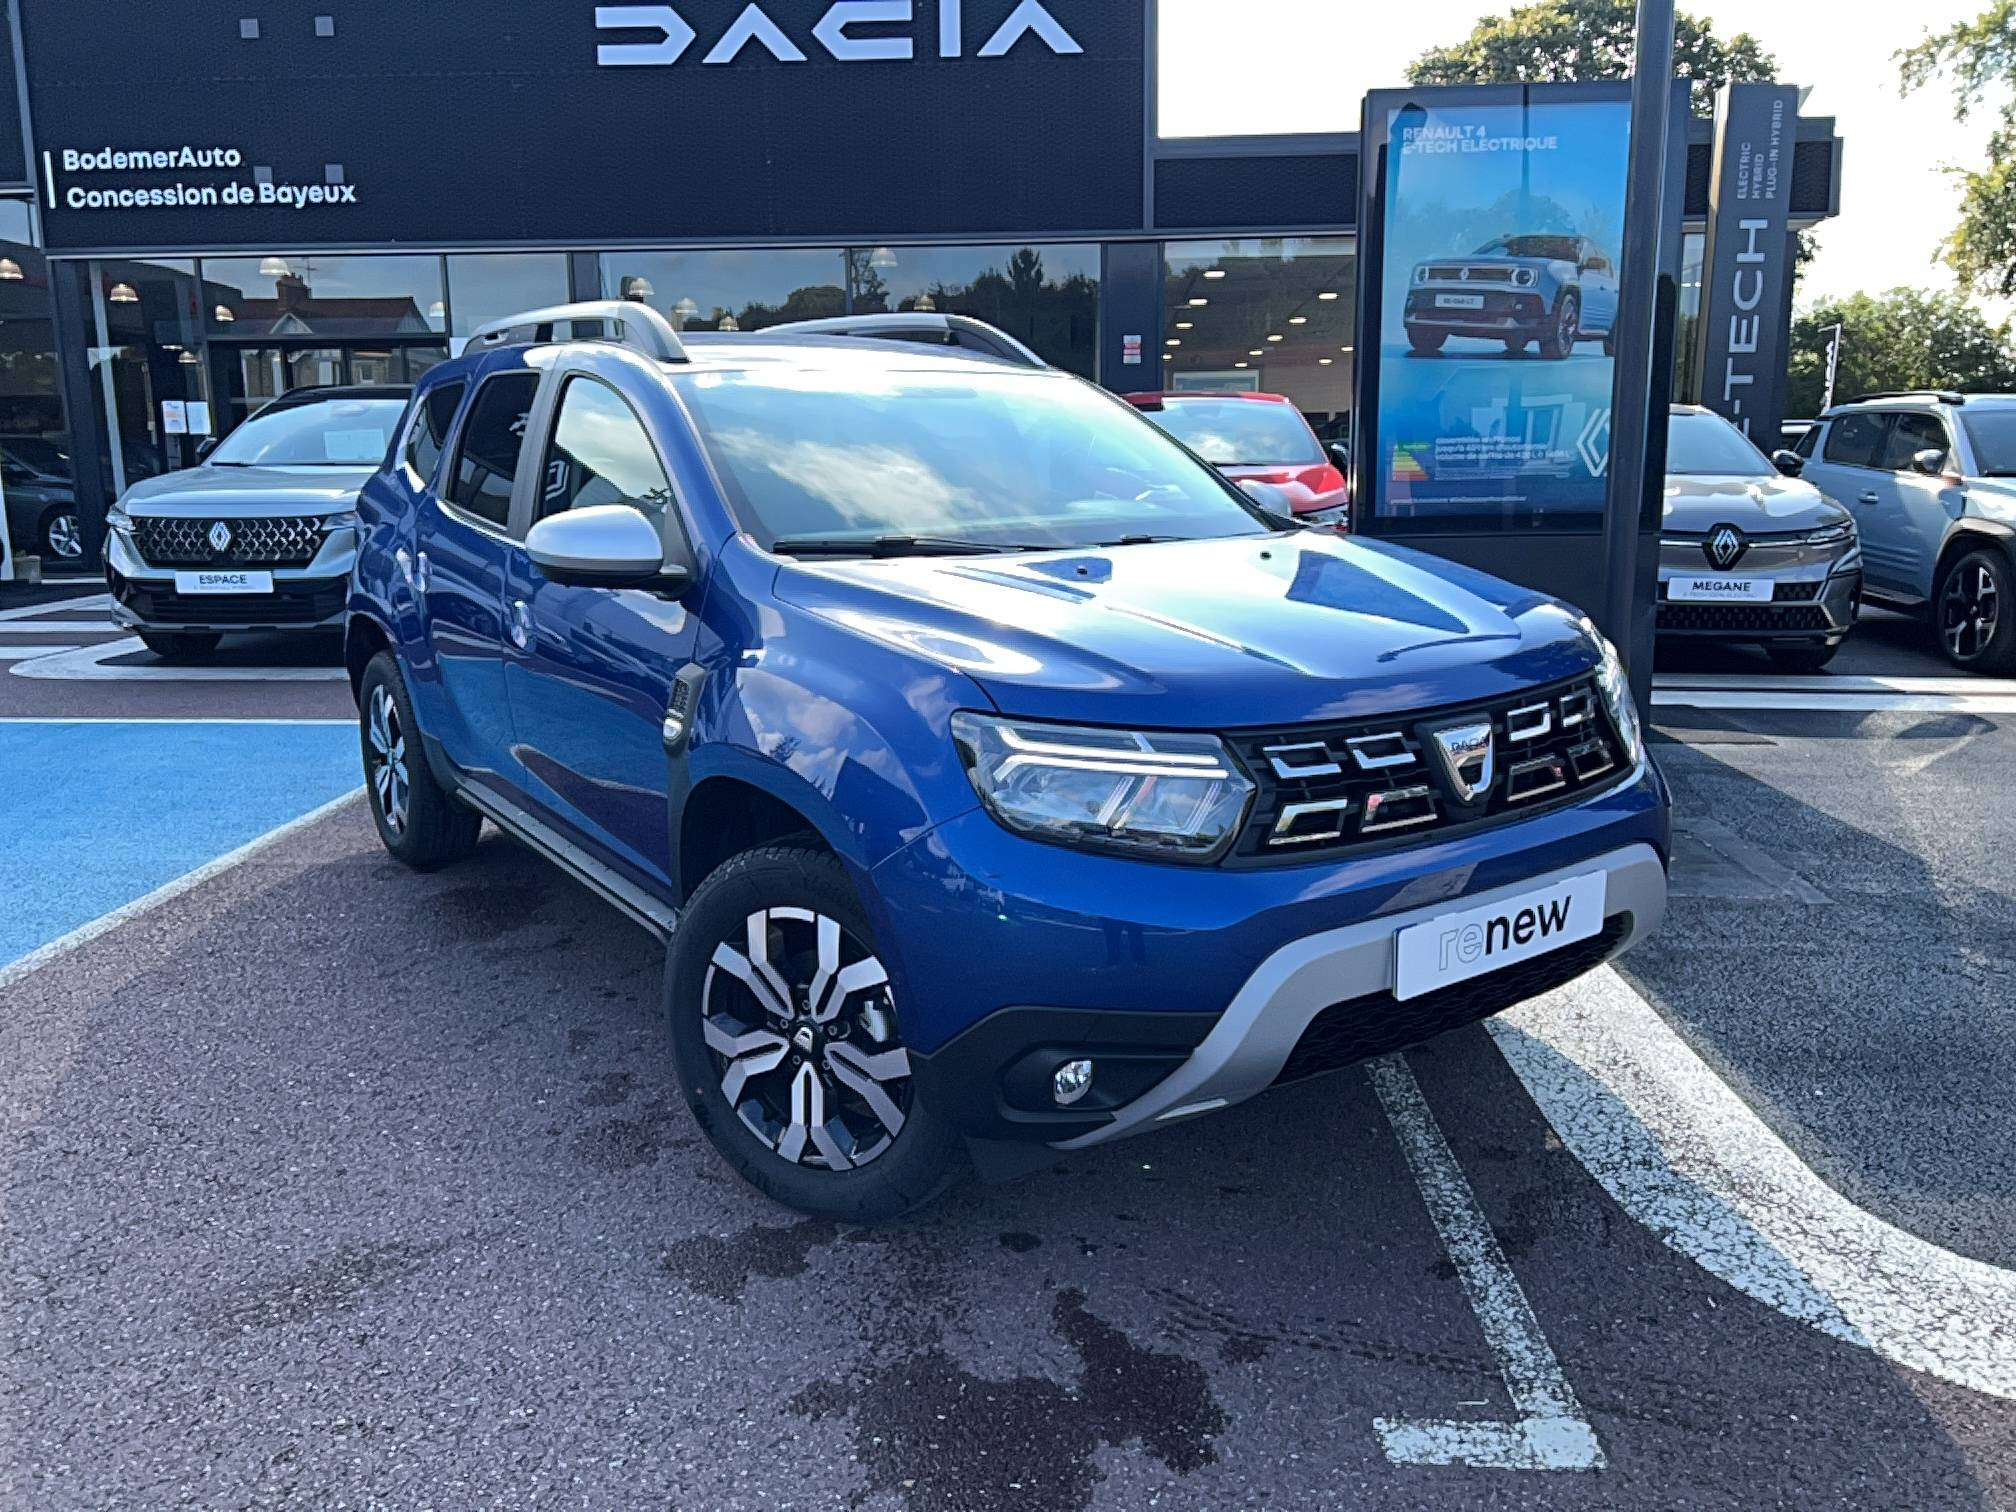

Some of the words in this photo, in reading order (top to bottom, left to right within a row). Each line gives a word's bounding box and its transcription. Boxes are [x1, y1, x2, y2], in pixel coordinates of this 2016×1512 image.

[595, 0, 1084, 65] DACIA
[1402, 126, 1474, 141] RENAULT
[1475, 125, 1487, 138] 4
[1771, 100, 1783, 145] HYBRID
[63, 146, 241, 171] BodemerAuto
[1402, 140, 1457, 155] E-TECH
[1737, 142, 1751, 199] ELECTRIC
[1752, 153, 1764, 199] HYBRID
[1765, 148, 1779, 199] PLUG-IN
[67, 183, 217, 208] Concession
[221, 181, 255, 204] de
[259, 182, 356, 209] Bayeux
[199, 574, 248, 585] ESPACE
[1692, 581, 1752, 592] MEGANE
[1439, 895, 1572, 972] renew
